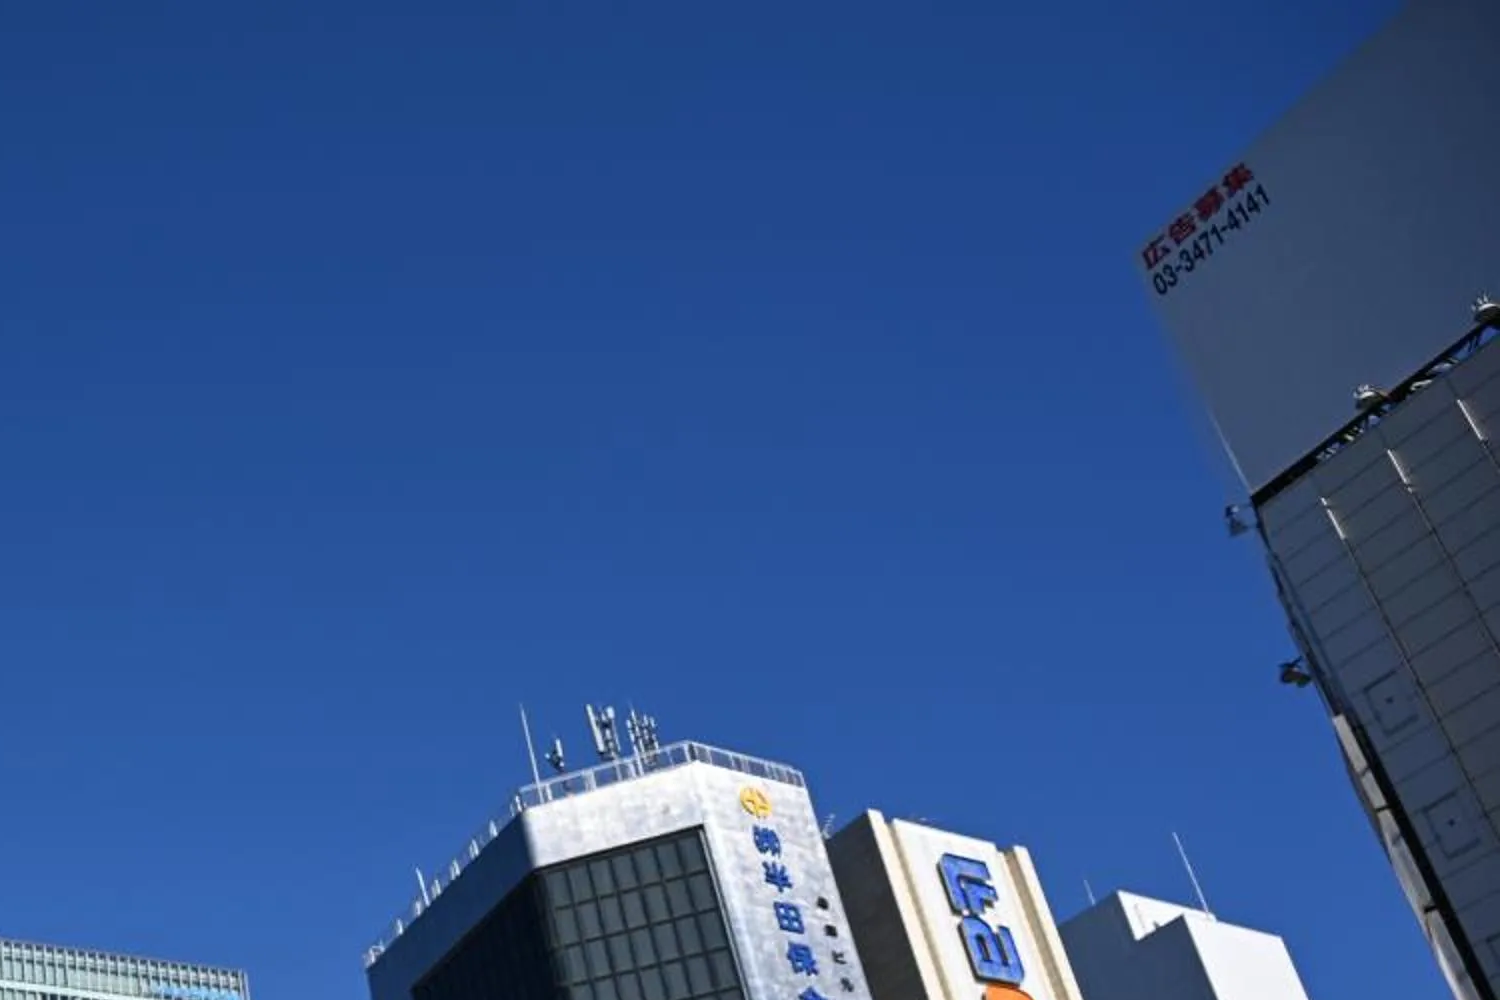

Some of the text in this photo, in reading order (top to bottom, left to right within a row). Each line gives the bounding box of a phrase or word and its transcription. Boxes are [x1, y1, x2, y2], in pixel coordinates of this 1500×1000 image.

[1142, 162, 1254, 270] 広告募集
[1153, 184, 1270, 295] 03-3471-4141
